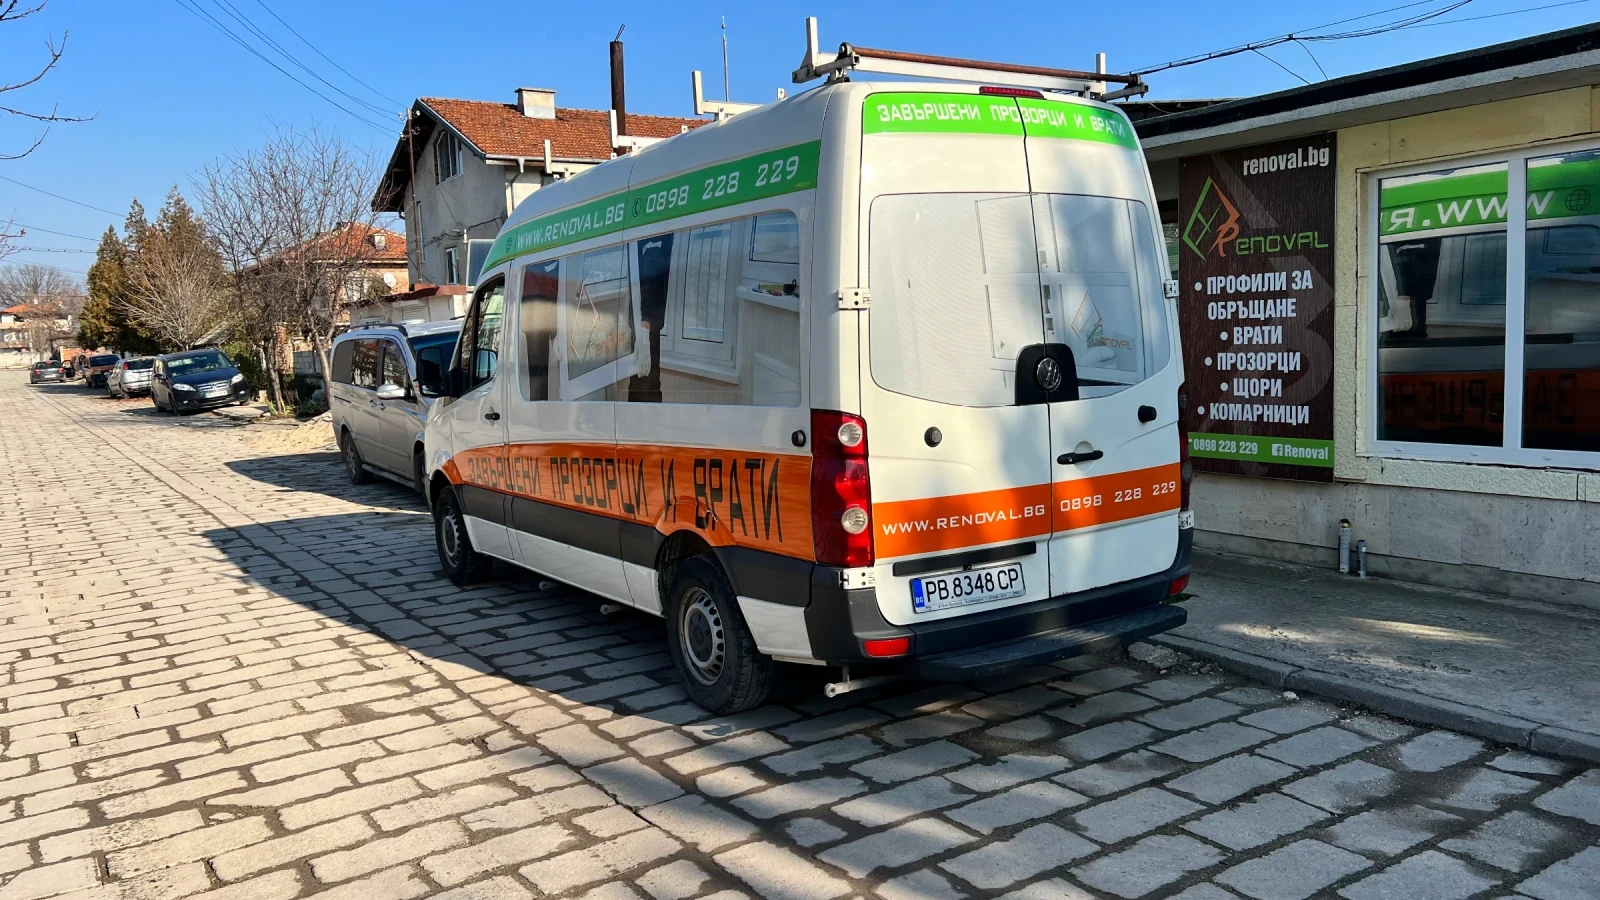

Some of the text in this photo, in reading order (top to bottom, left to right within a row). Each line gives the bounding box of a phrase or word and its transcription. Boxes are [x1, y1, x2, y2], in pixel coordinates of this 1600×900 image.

[877, 104, 1126, 138] ЗАВЪРШЕНИ ПРОЗОРЦИ И ВРАТИ
[1243, 146, 1329, 176] renoval.bg
[517, 156, 799, 249] WWW.RENOVAL.BG 0898 228 229
[1207, 270, 1314, 295] ПРОФИЛИ ЗА
[1207, 298, 1297, 320] ОБРЪЩАНЕ
[1233, 326, 1283, 345] ВРАТИ
[1217, 352, 1301, 373] ПРОЗОРЦИ
[1233, 378, 1282, 399] ЩОРИ
[1209, 403, 1310, 425] КОМАРНИЦИ
[1193, 438, 1329, 460] 0898 228 229 Renoval
[550, 457, 649, 520] ПРОЗОРЦИ
[661, 458, 677, 523] И
[693, 458, 783, 542] ВРАТИ
[882, 481, 1176, 535] WWW.RENOVAL.BG 0898 228 229
